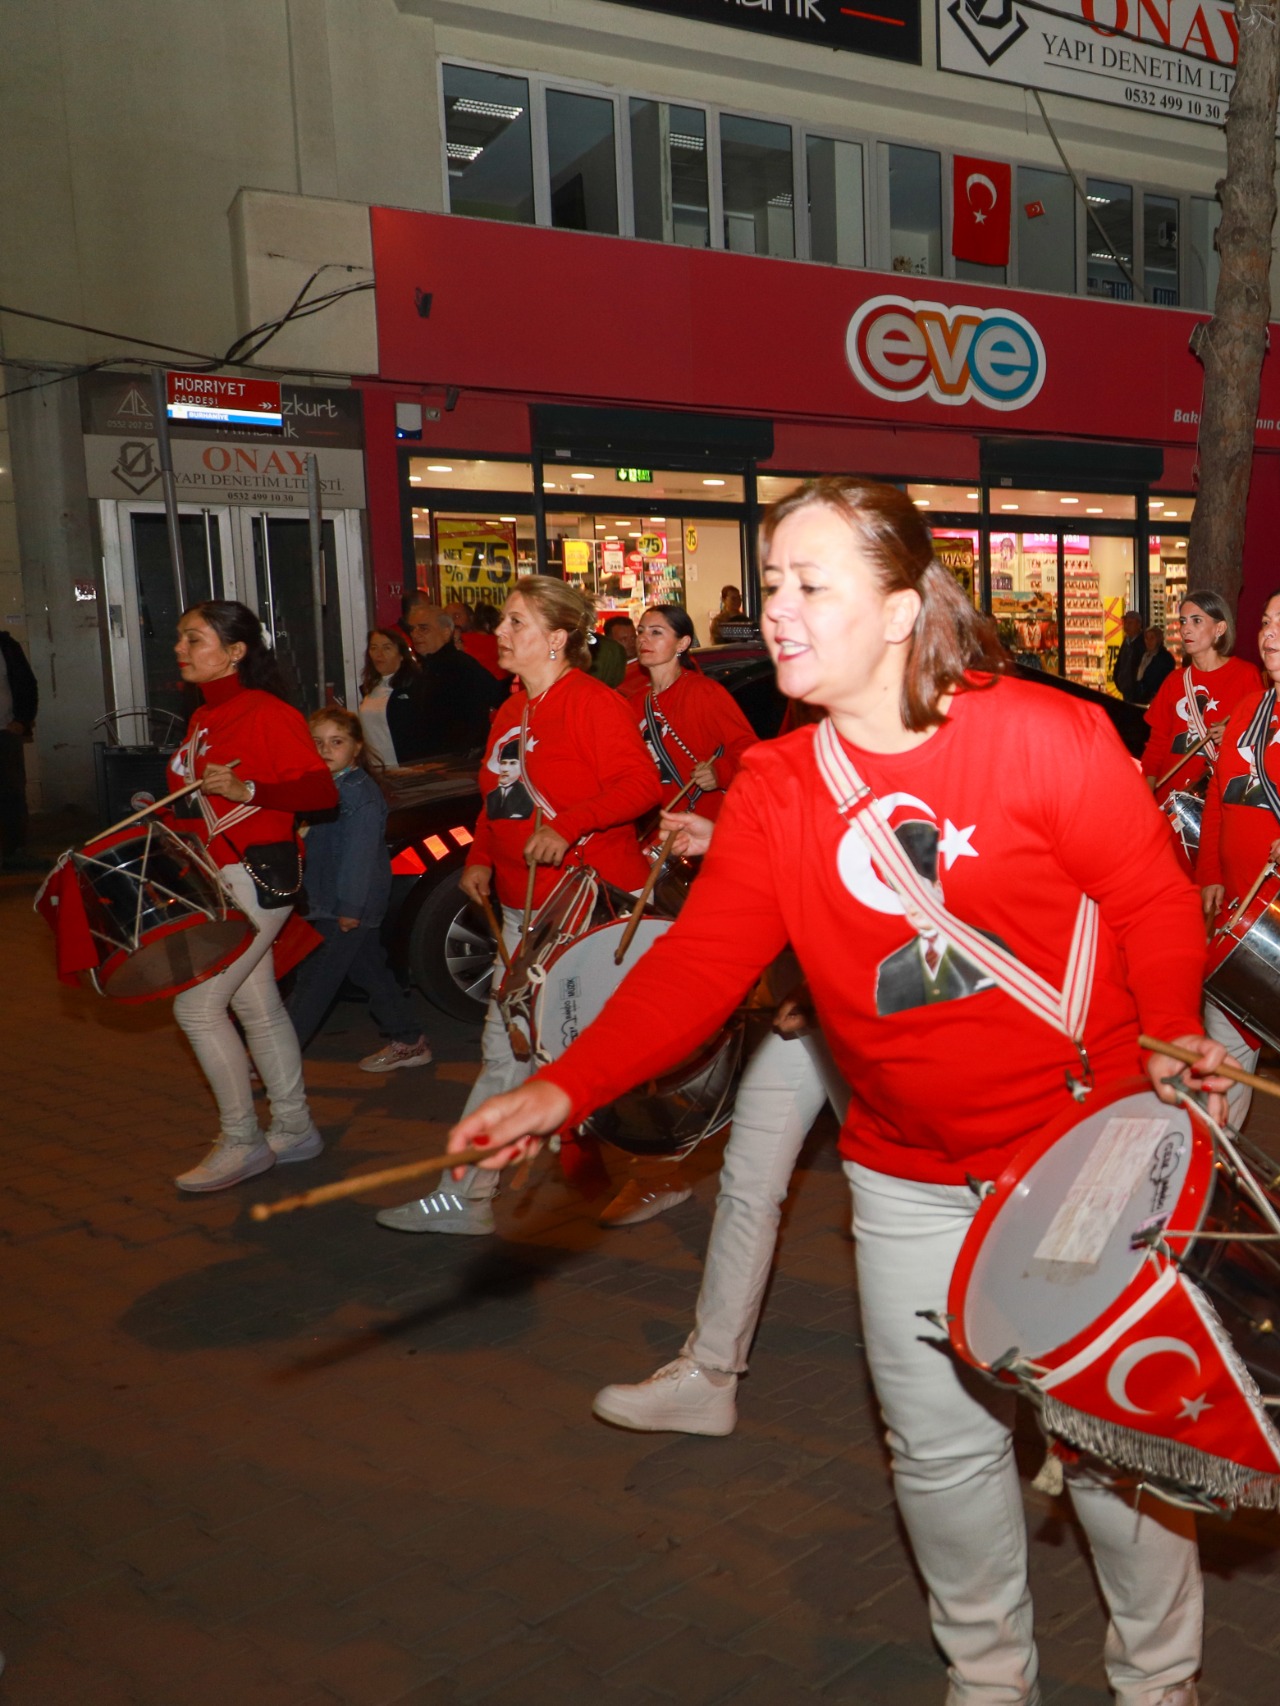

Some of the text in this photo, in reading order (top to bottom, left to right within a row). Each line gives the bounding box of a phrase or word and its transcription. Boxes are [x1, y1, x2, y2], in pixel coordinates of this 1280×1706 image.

[1041, 32, 1236, 93] YAPI DENETİM LT
[1124, 87, 1221, 119] 0532 499 10 30
[857, 304, 1038, 400] eve
[174, 376, 246, 397] HÜRRİYET
[282, 393, 338, 418] zkurt
[202, 446, 312, 476] ONAY
[173, 472, 206, 485] YAPI
[211, 474, 280, 488] DENETİM
[227, 492, 294, 502] 0532 499 10 30
[643, 537, 660, 553] 75
[443, 541, 511, 584] NET 75
